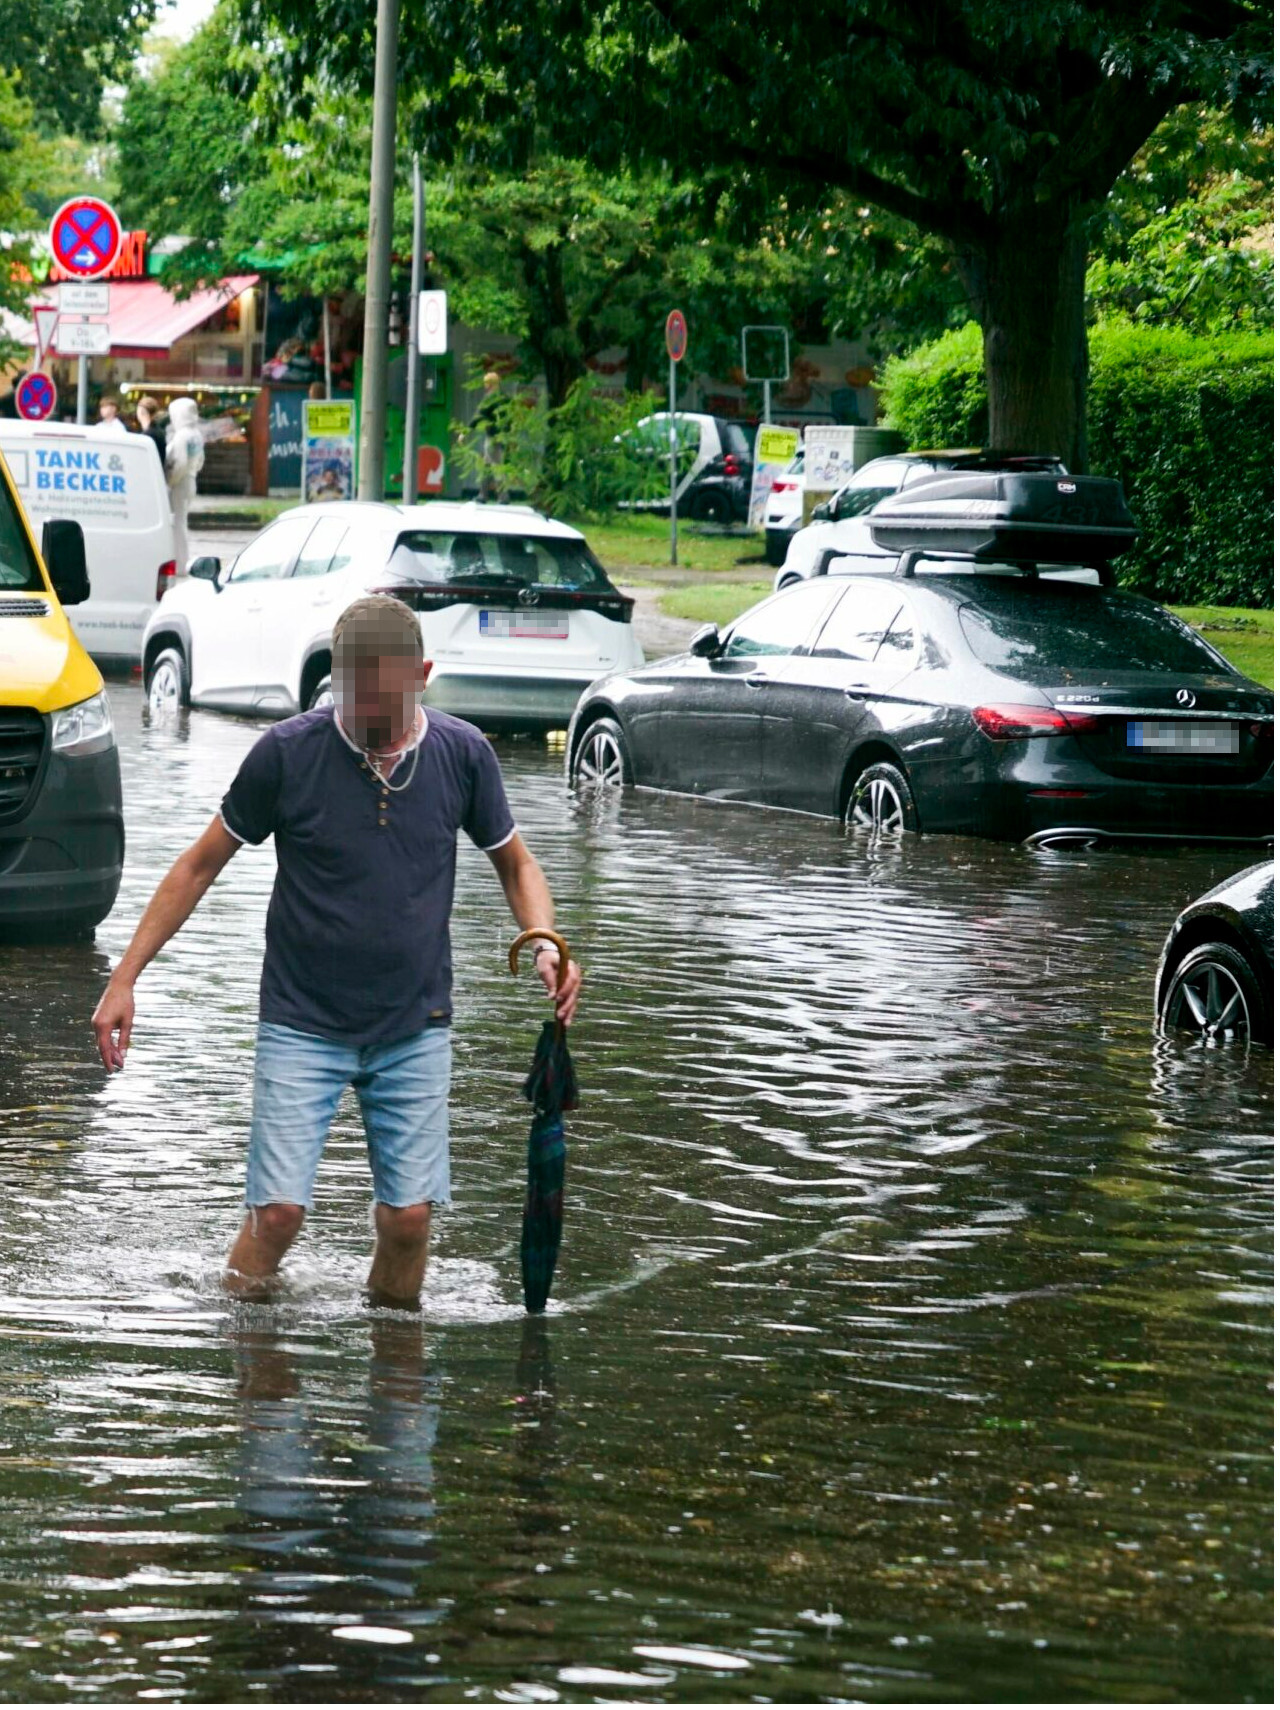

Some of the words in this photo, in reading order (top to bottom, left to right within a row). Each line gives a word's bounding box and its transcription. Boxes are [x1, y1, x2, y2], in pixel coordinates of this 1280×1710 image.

[36, 450, 100, 470] TANK
[107, 454, 124, 472] &
[37, 471, 127, 493] BECKER
